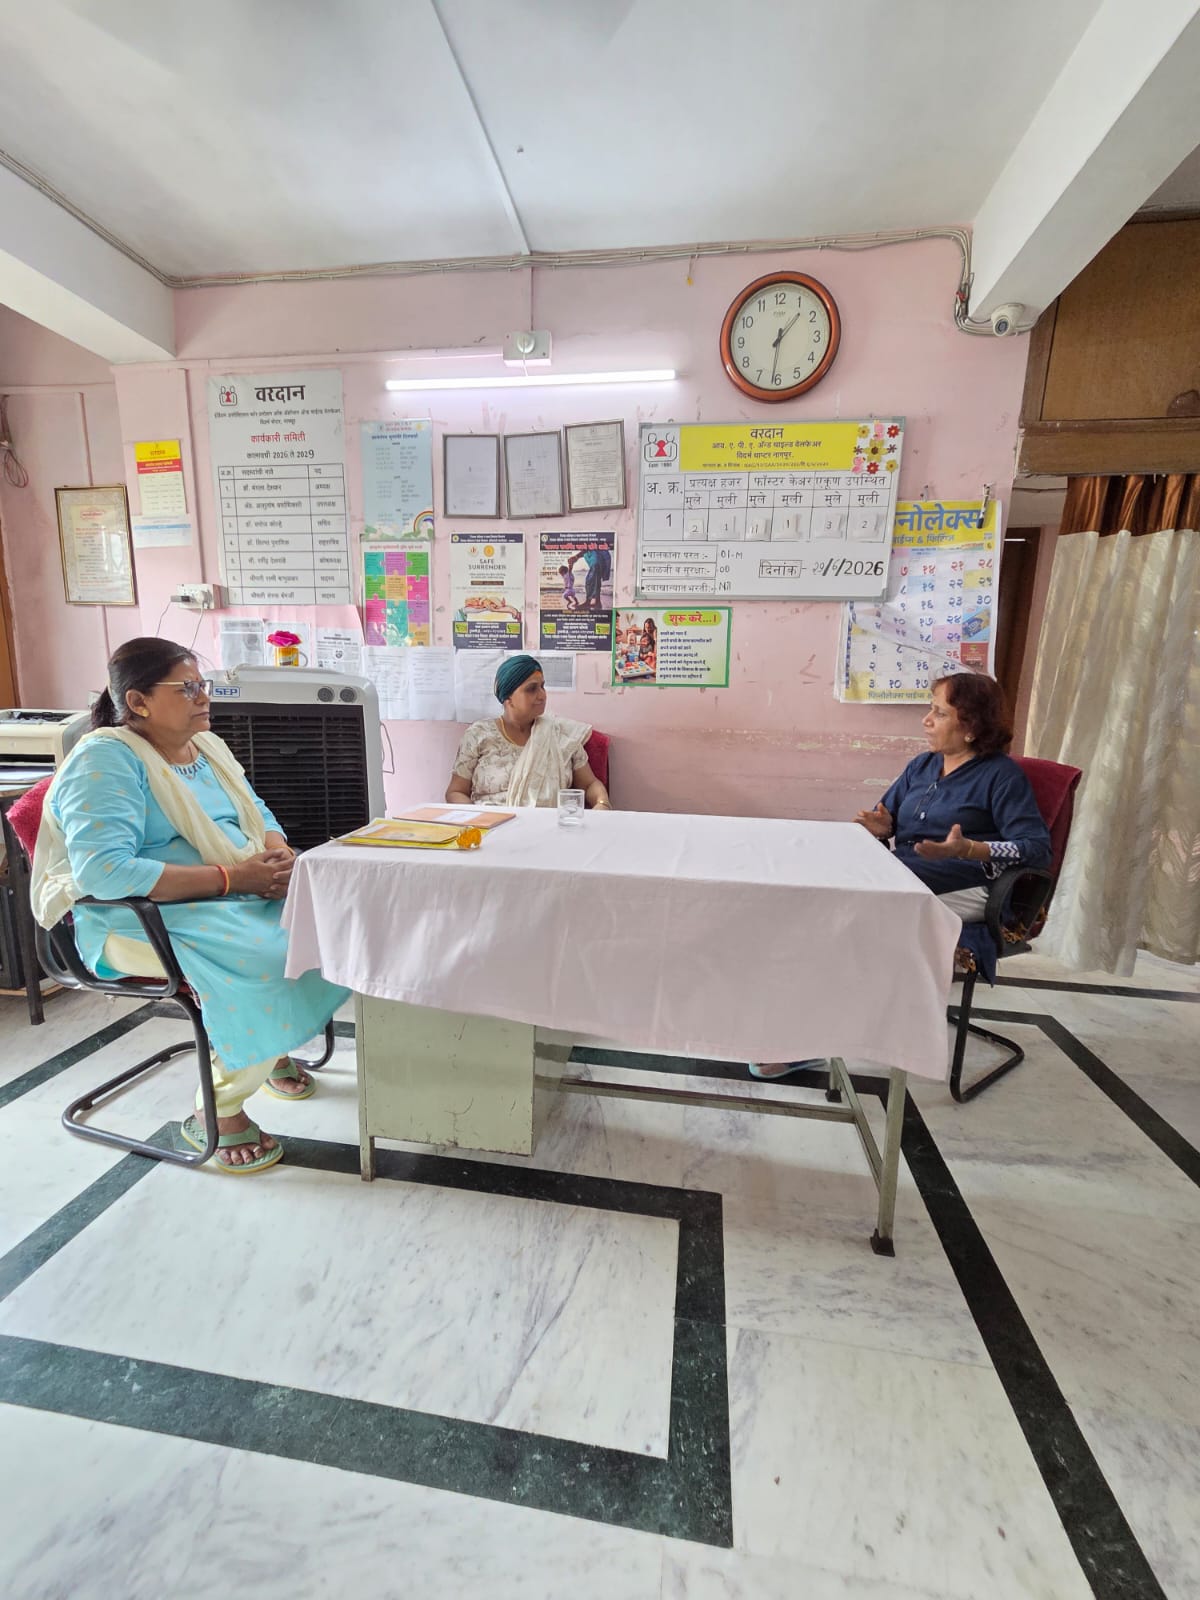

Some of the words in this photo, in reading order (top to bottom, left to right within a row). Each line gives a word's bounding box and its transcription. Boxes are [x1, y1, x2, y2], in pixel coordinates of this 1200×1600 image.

[774, 293, 786, 305] 12
[797, 296, 801, 308] 1
[758, 299, 766, 312] 11
[742, 316, 754, 328] 10
[809, 310, 816, 323] 2
[737, 337, 745, 348] 9
[813, 330, 821, 343] 3
[742, 356, 750, 368] 8
[808, 351, 815, 363] 4
[756, 369, 763, 382] 7
[793, 367, 801, 379] 5
[774, 374, 782, 386] 6
[255, 385, 306, 403] वरदान
[251, 432, 281, 443] कार्यकारी
[284, 431, 306, 442] समिती
[750, 427, 784, 441] वरदान
[272, 451, 288, 459] 2026
[297, 449, 315, 460] 2029
[689, 478, 718, 489] प्रत्यक्ष
[720, 478, 743, 489] हजर
[754, 474, 786, 487] फॉस्टर
[845, 473, 887, 487] उपस्थित
[686, 493, 702, 510] मुले
[717, 492, 738, 509] मुली
[749, 491, 767, 508] मुले
[782, 491, 803, 507] मुली
[825, 491, 843, 508] मुले
[857, 490, 880, 507] मुली
[665, 513, 672, 527] 1
[895, 503, 983, 531] नोलेक्स
[691, 524, 699, 533] 2
[826, 521, 832, 530] 3
[861, 520, 868, 529] 2
[760, 559, 798, 576] दिनांक
[978, 558, 993, 569] २८
[922, 564, 936, 576] १४
[949, 579, 964, 589] २२
[948, 596, 963, 607] २३
[977, 595, 992, 605] ३०
[946, 615, 962, 625] २४
[916, 661, 929, 671] १६
[868, 679, 875, 689] ३
[889, 679, 903, 689] १०
[915, 679, 929, 689] १७
[215, 688, 238, 696] SEP
